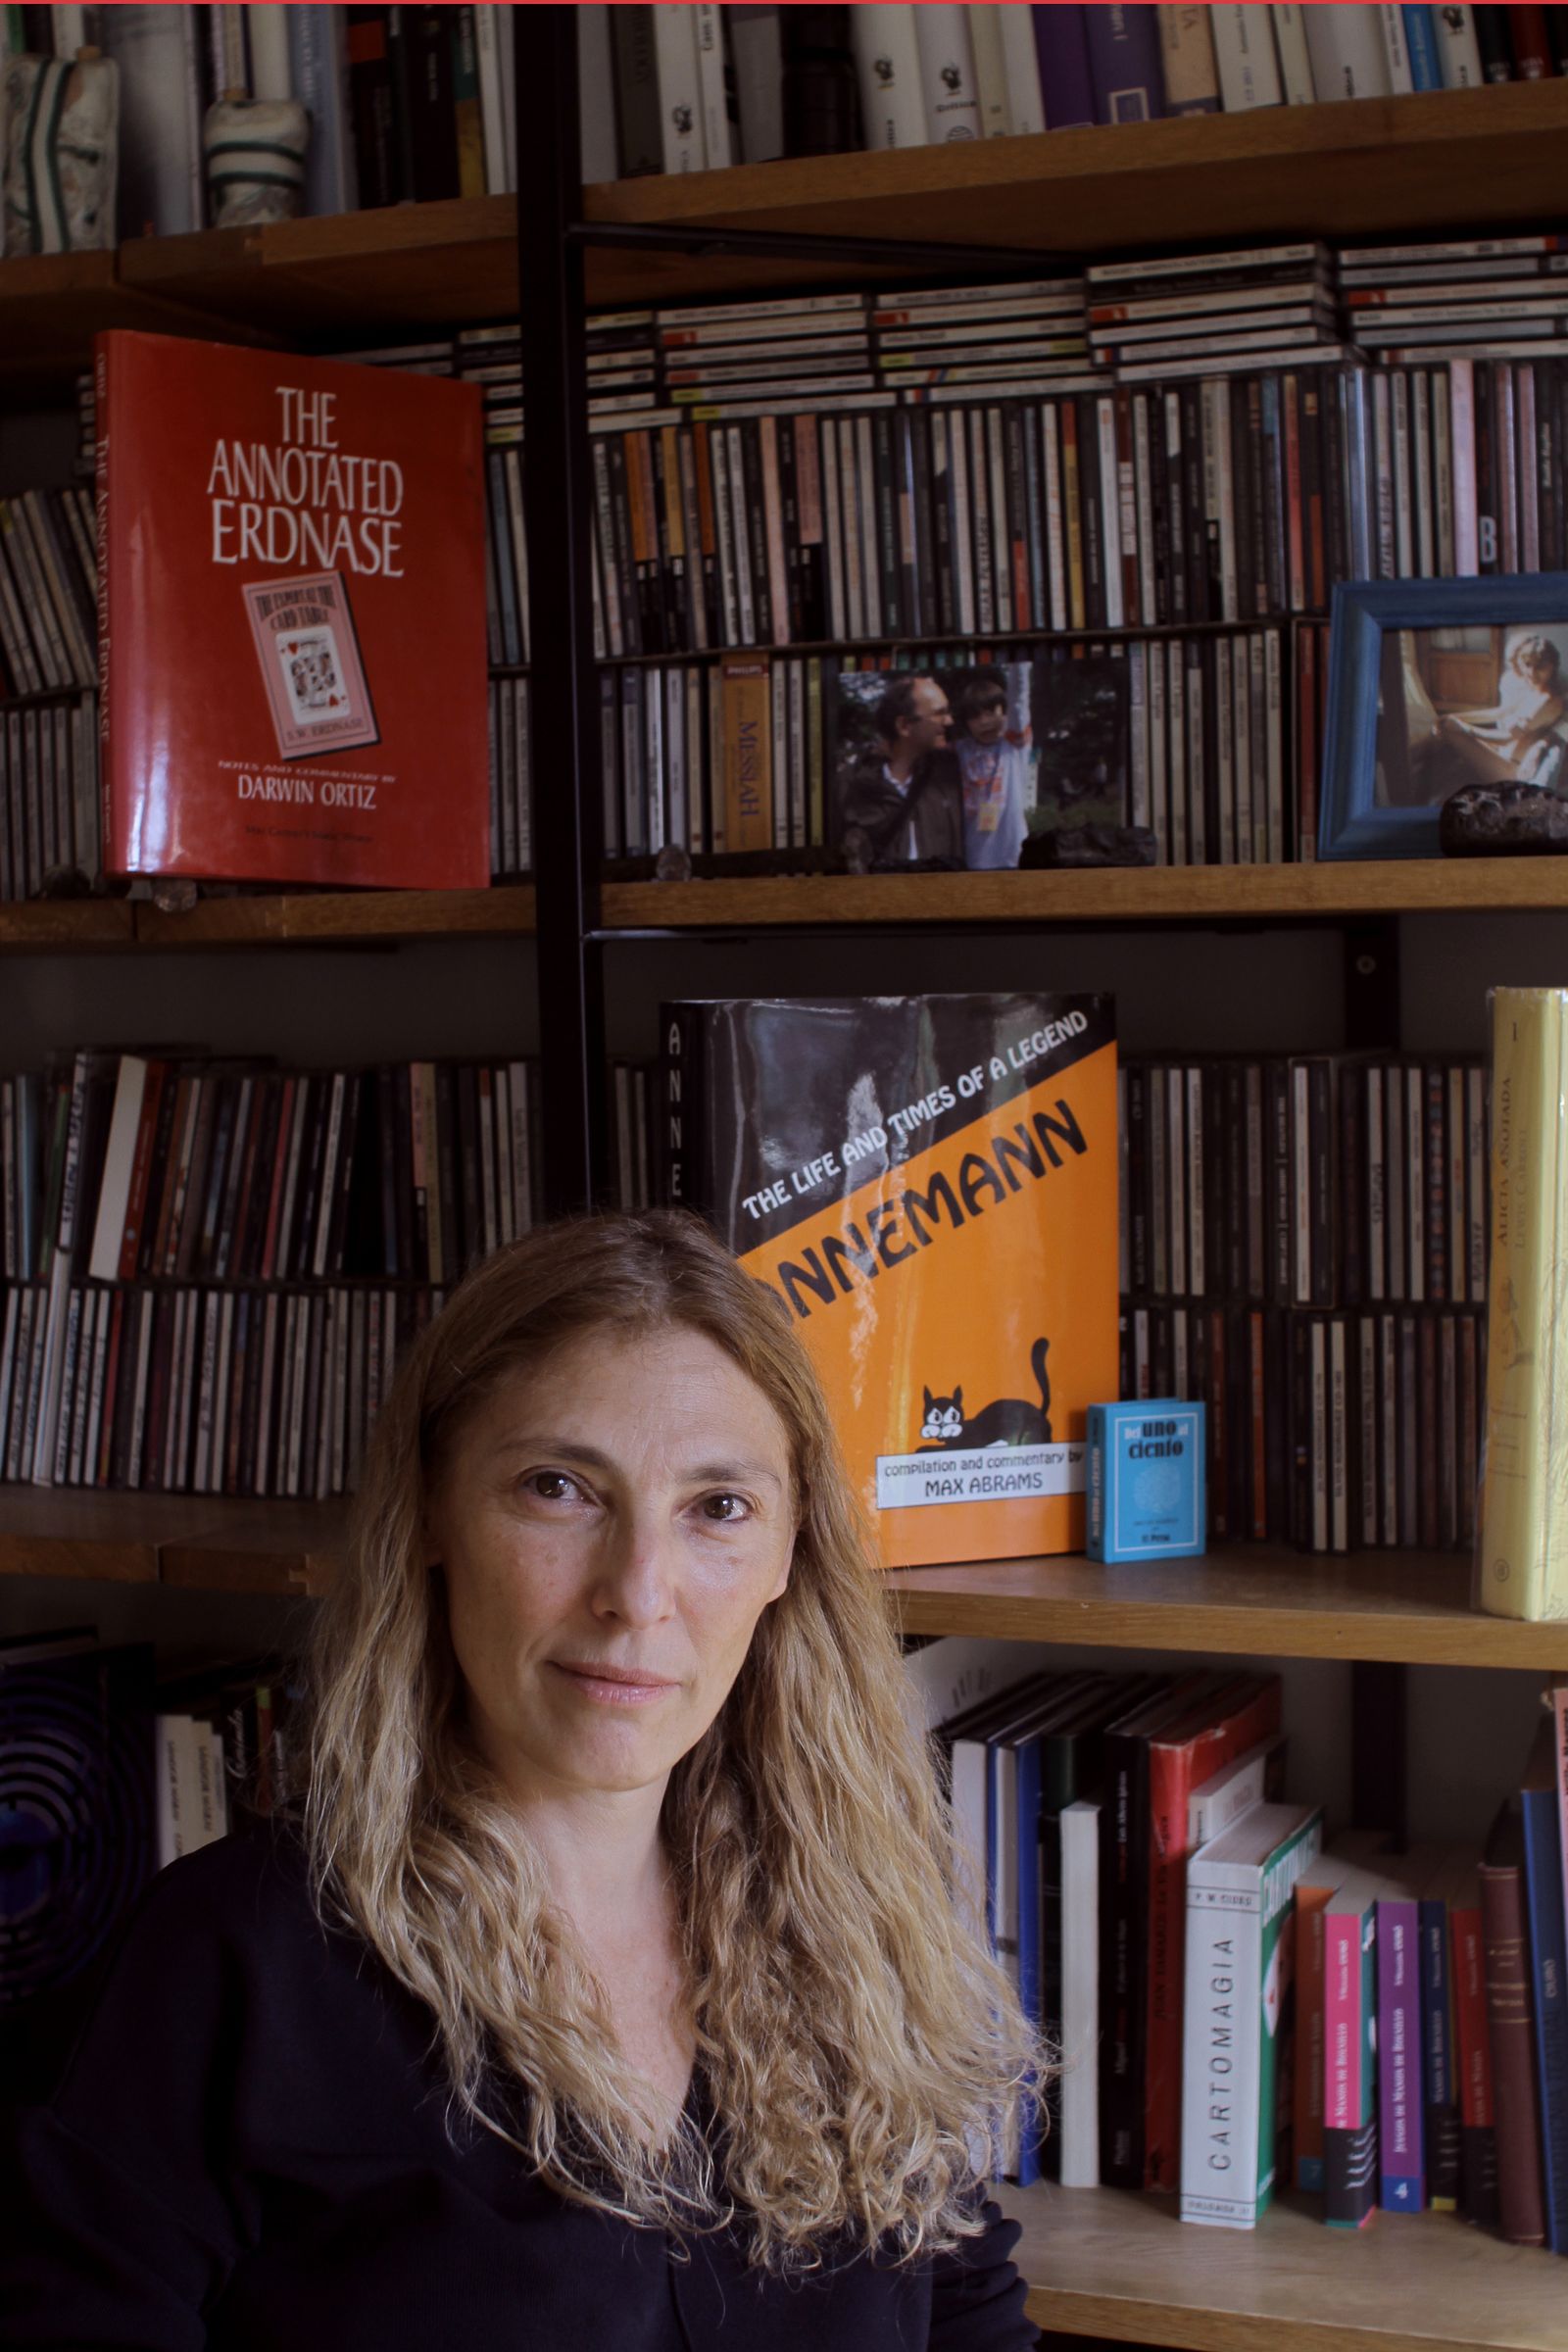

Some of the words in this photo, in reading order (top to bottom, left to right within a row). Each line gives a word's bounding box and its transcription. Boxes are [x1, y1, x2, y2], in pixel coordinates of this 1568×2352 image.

[274, 386, 339, 450] THE
[96, 434, 110, 480] THE
[207, 438, 405, 517] ANNOTATED
[96, 490, 110, 633] ANNOTATED
[211, 498, 405, 578] ERDNASE
[99, 637, 111, 743] ERDNASE
[237, 773, 315, 805] DARWIN
[319, 781, 377, 810] ORTIZ
[263, 763, 292, 774] AND
[738, 720, 760, 816] MESSIAH
[742, 1181, 793, 1220] THE
[790, 1154, 841, 1196] LIFE
[840, 1125, 889, 1166] AND
[887, 1085, 957, 1140] TIMES
[956, 1068, 985, 1099] OF
[989, 1055, 1008, 1083] A
[1006, 1009, 1089, 1070] LEGEND
[1143, 1420, 1177, 1438] uno
[884, 1457, 957, 1478] compilation
[960, 1455, 984, 1471] and
[987, 1450, 1065, 1468] commentary
[1067, 1448, 1084, 1463] by
[924, 1478, 965, 1497] MAX
[969, 1473, 1044, 1494] ABRAMS
[1208, 1938, 1235, 2171] CARTOMAGIA
[1393, 2182, 1409, 2200] 4
